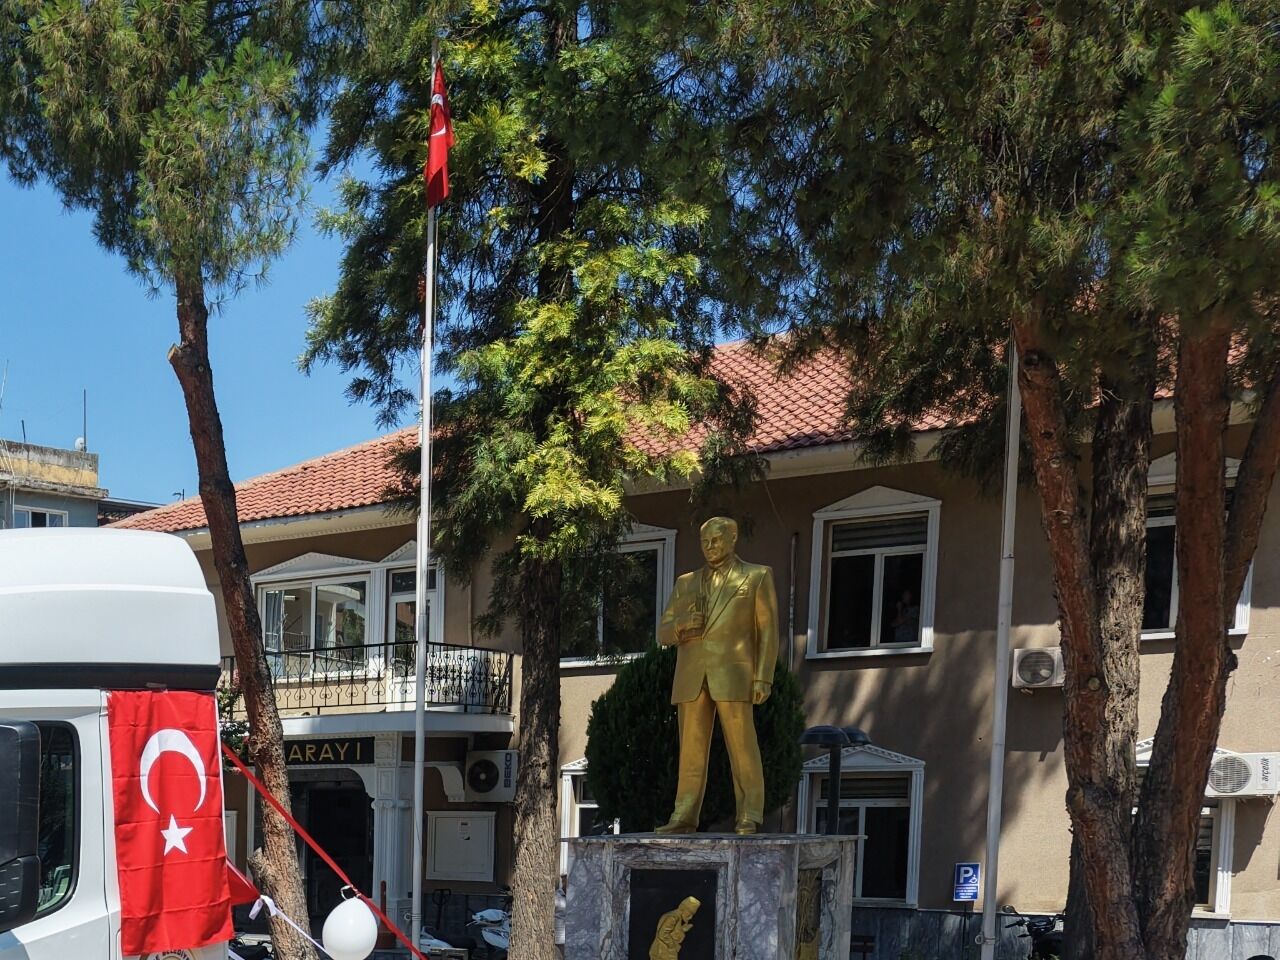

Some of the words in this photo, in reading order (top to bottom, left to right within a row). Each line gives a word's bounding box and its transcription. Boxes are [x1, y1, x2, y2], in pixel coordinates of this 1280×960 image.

[288, 742, 361, 762] ARAYI
[503, 752, 512, 788] BEKO
[960, 866, 974, 884] P
